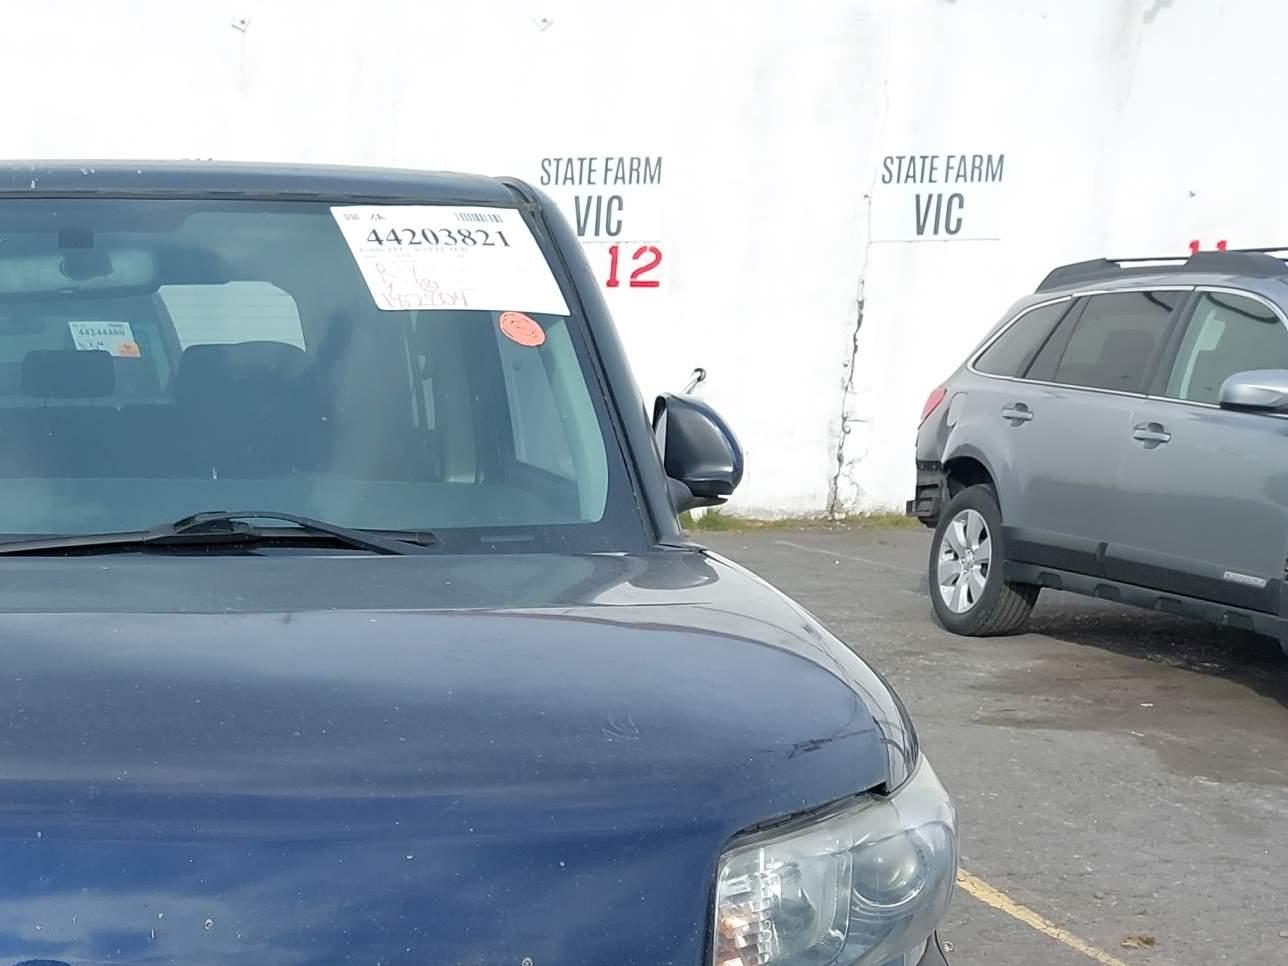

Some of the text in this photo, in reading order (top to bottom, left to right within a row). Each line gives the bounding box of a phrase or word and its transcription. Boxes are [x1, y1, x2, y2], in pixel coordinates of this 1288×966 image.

[541, 157, 661, 186] STATE FARM
[882, 154, 1004, 184] STATE FARM
[575, 195, 623, 237] VIC
[915, 193, 964, 236] VIC
[367, 228, 511, 248] 44203821
[606, 245, 663, 288] 12
